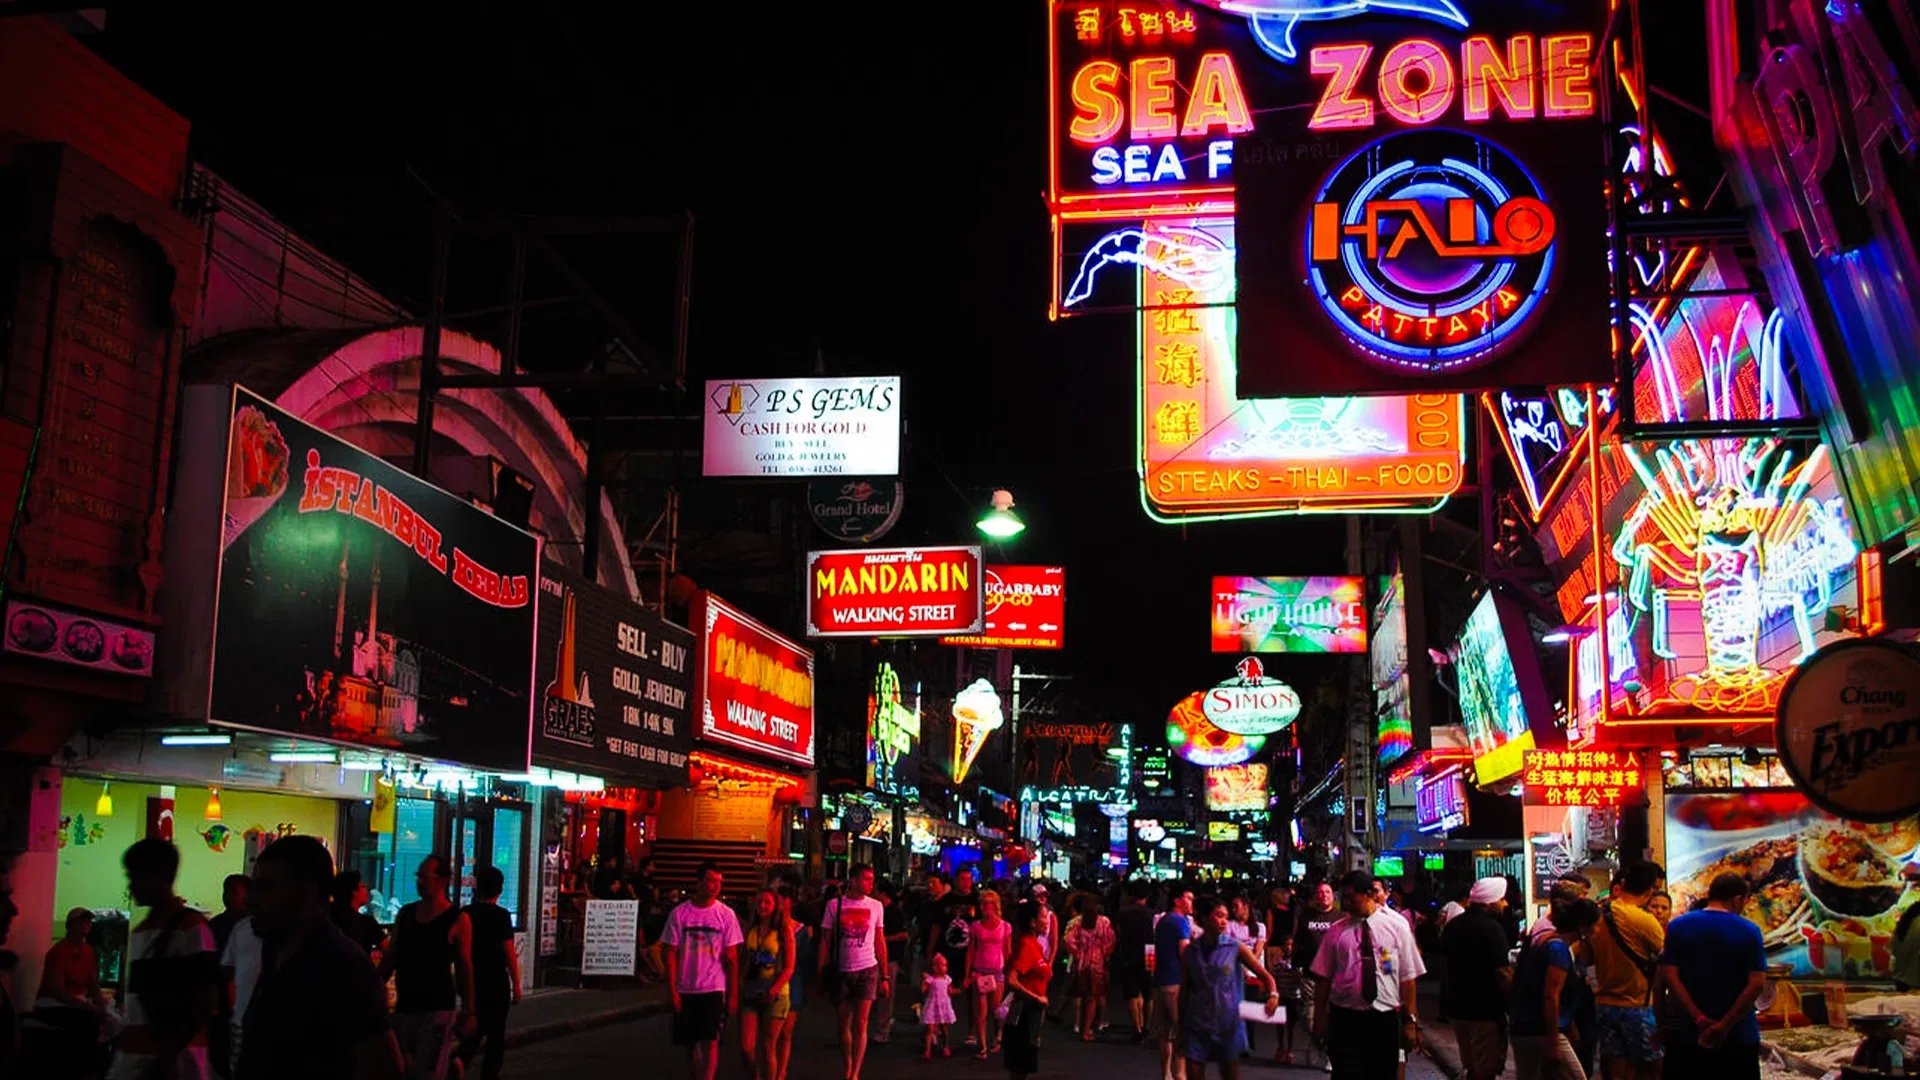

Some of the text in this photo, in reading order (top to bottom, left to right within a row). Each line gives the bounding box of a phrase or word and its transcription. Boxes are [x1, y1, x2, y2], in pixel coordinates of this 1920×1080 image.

[1069, 34, 1598, 144] SEA ZONE
[1091, 143, 1187, 185] SEA
[1312, 196, 1557, 261] HALO
[1340, 284, 1519, 341] PATTAYA
[766, 385, 894, 419] PS GEMS
[740, 422, 866, 436] CASH FOR GOLD
[755, 453, 785, 461] GOLD
[813, 465, 843, 473] 413261
[1159, 468, 1261, 494] STEAKS
[1288, 465, 1348, 489] THAI
[1378, 463, 1454, 487] FOOD
[814, 503, 891, 517] Grand Hotel
[452, 547, 530, 609] KEBAB
[816, 561, 969, 599] MANDARIN
[832, 604, 957, 624] WALKING STREET
[1216, 602, 1361, 625] LIGHTHOUSE
[617, 621, 648, 660] SELL
[661, 640, 687, 674] BUY
[944, 635, 980, 645] PATTAYA
[612, 666, 687, 712] GOLD, JEWELRY
[1841, 684, 1907, 708] Chang
[623, 705, 641, 728] 18K
[643, 711, 661, 733] 14K
[727, 699, 799, 744] WALKING STREET
[1020, 786, 1130, 804] ALCATRAZ
[1545, 787, 1621, 805] 价格公平
